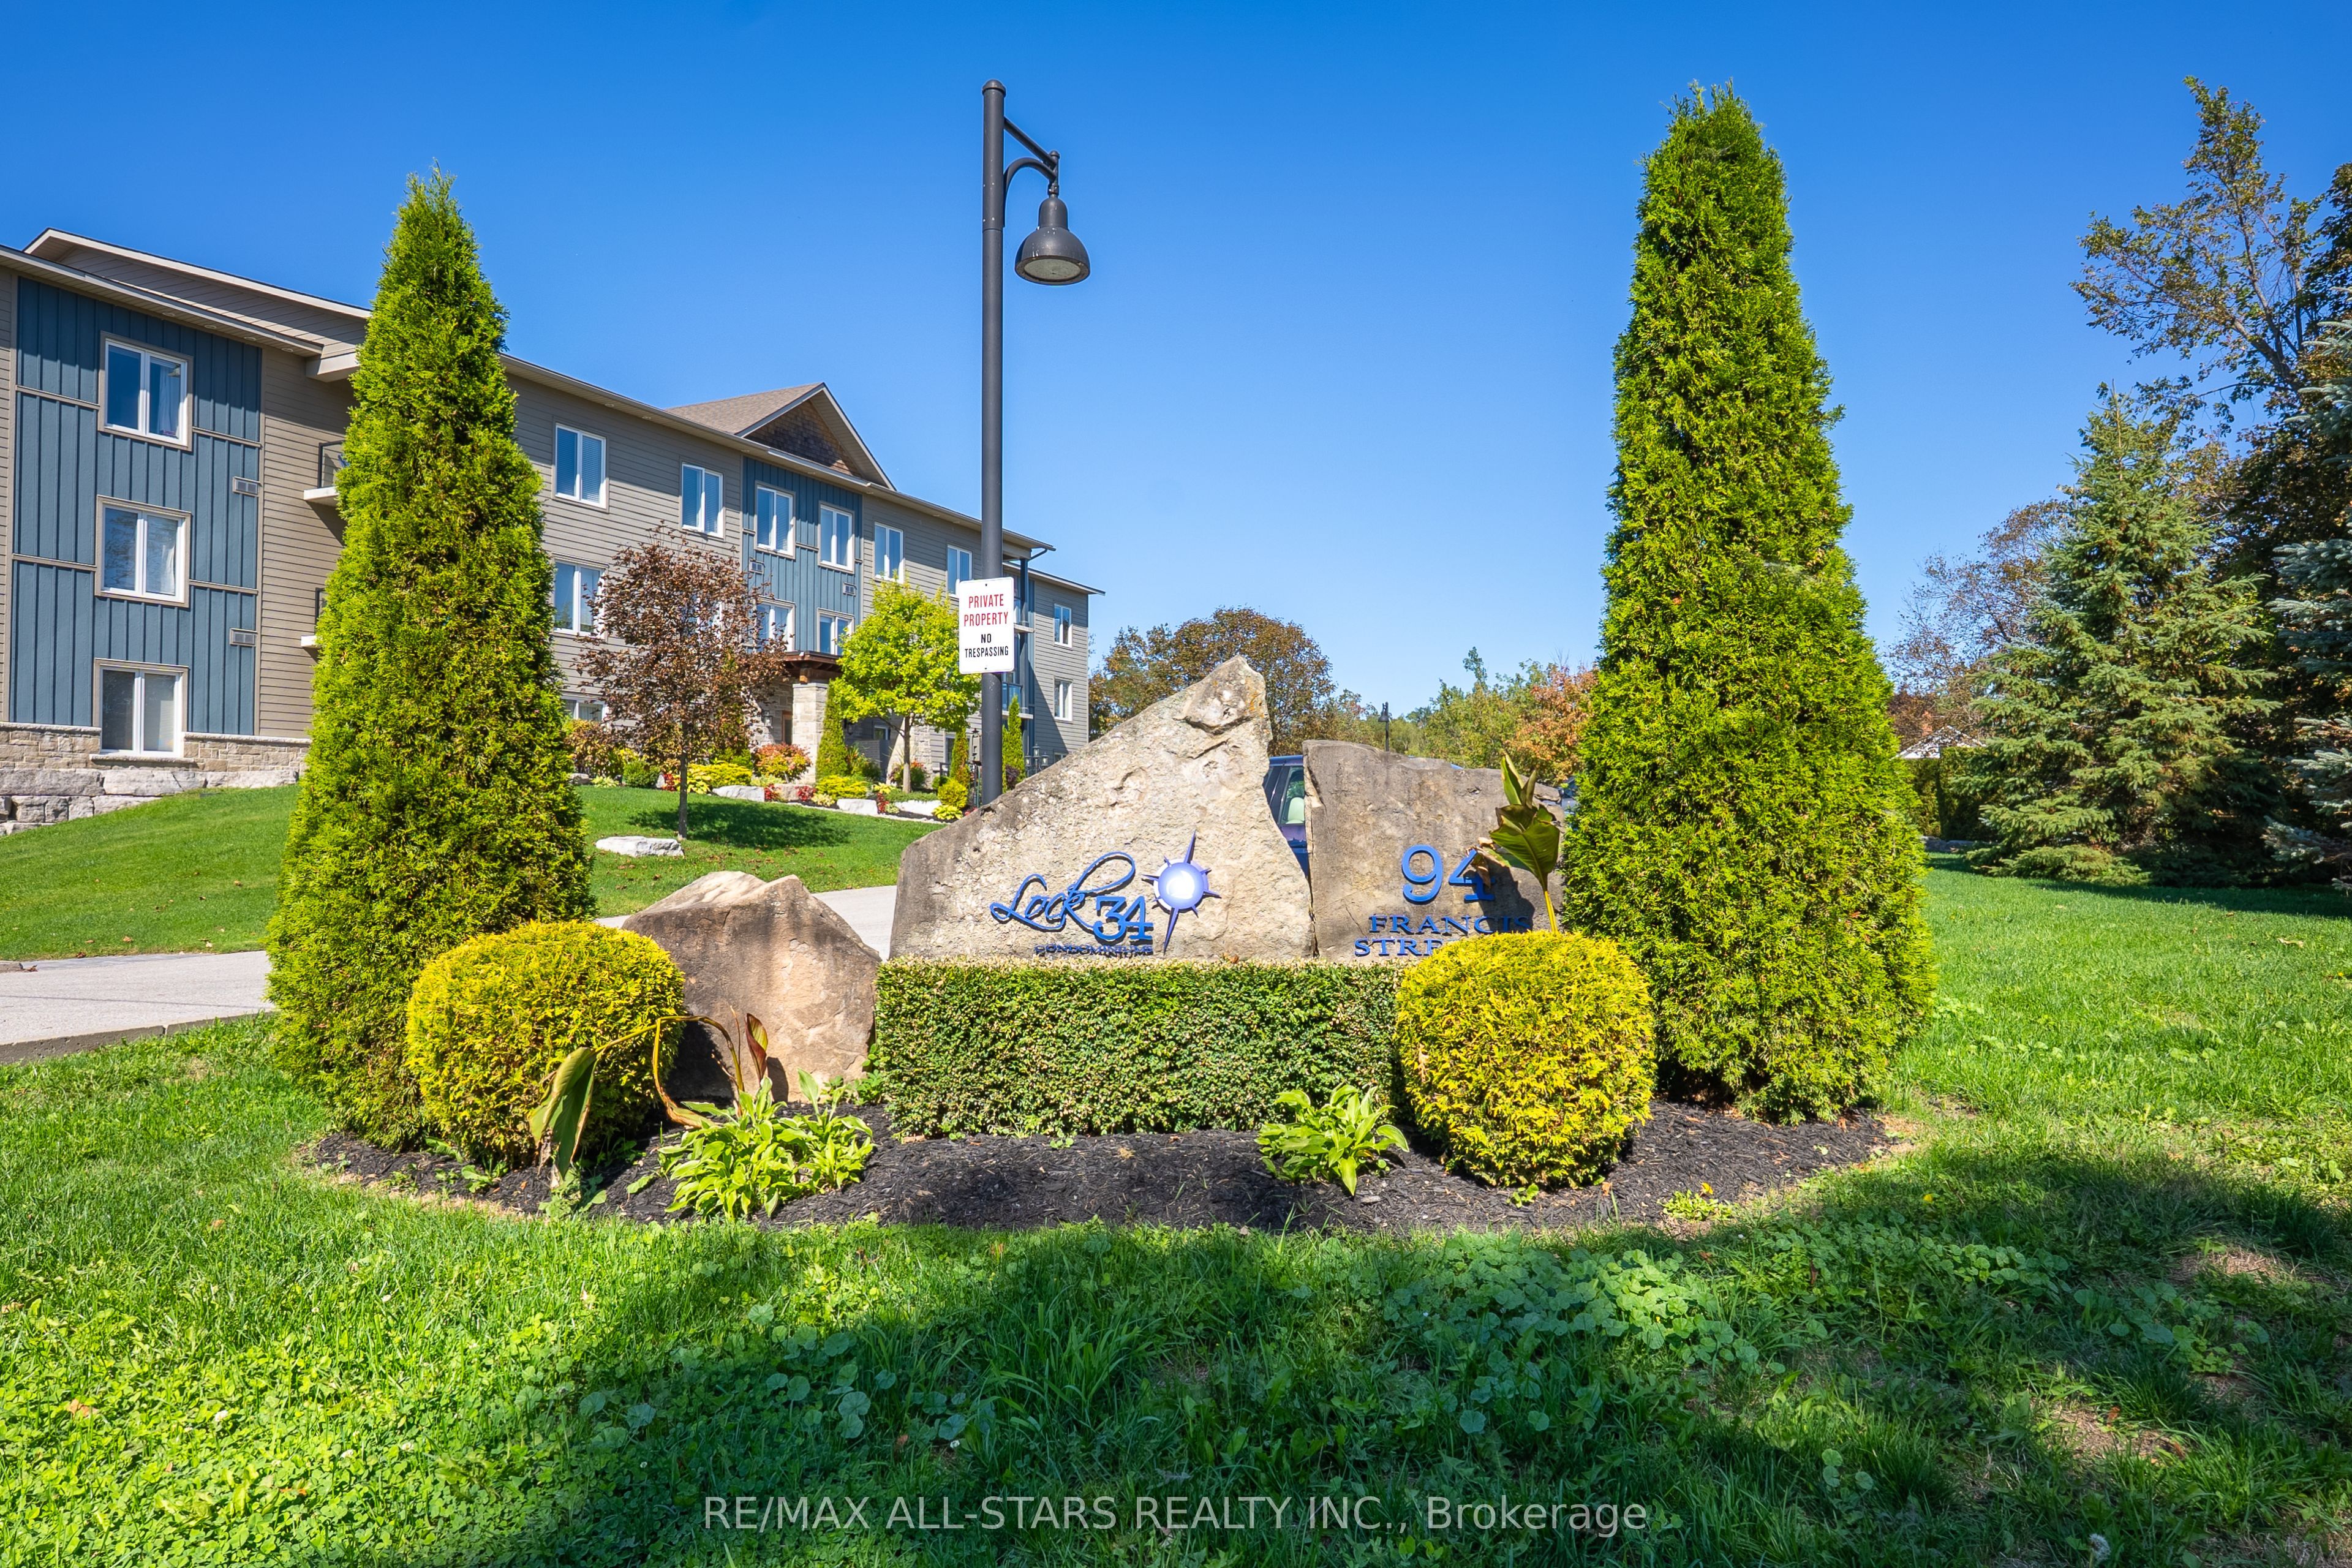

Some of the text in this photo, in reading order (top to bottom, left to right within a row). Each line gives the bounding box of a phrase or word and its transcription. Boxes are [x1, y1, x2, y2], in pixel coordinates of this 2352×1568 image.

[968, 594, 1004, 608] PRIVATE
[964, 612, 1008, 627] PROPERTY
[981, 633, 992, 643] NO
[965, 646, 1008, 658] TRESPASSING
[1401, 845, 1495, 902] 94
[990, 851, 1153, 940] Lock 34
[1369, 914, 1532, 933] FRANCIS
[1035, 943, 1153, 955] CONDOMINIUMS
[1354, 938, 1460, 956] STRE
